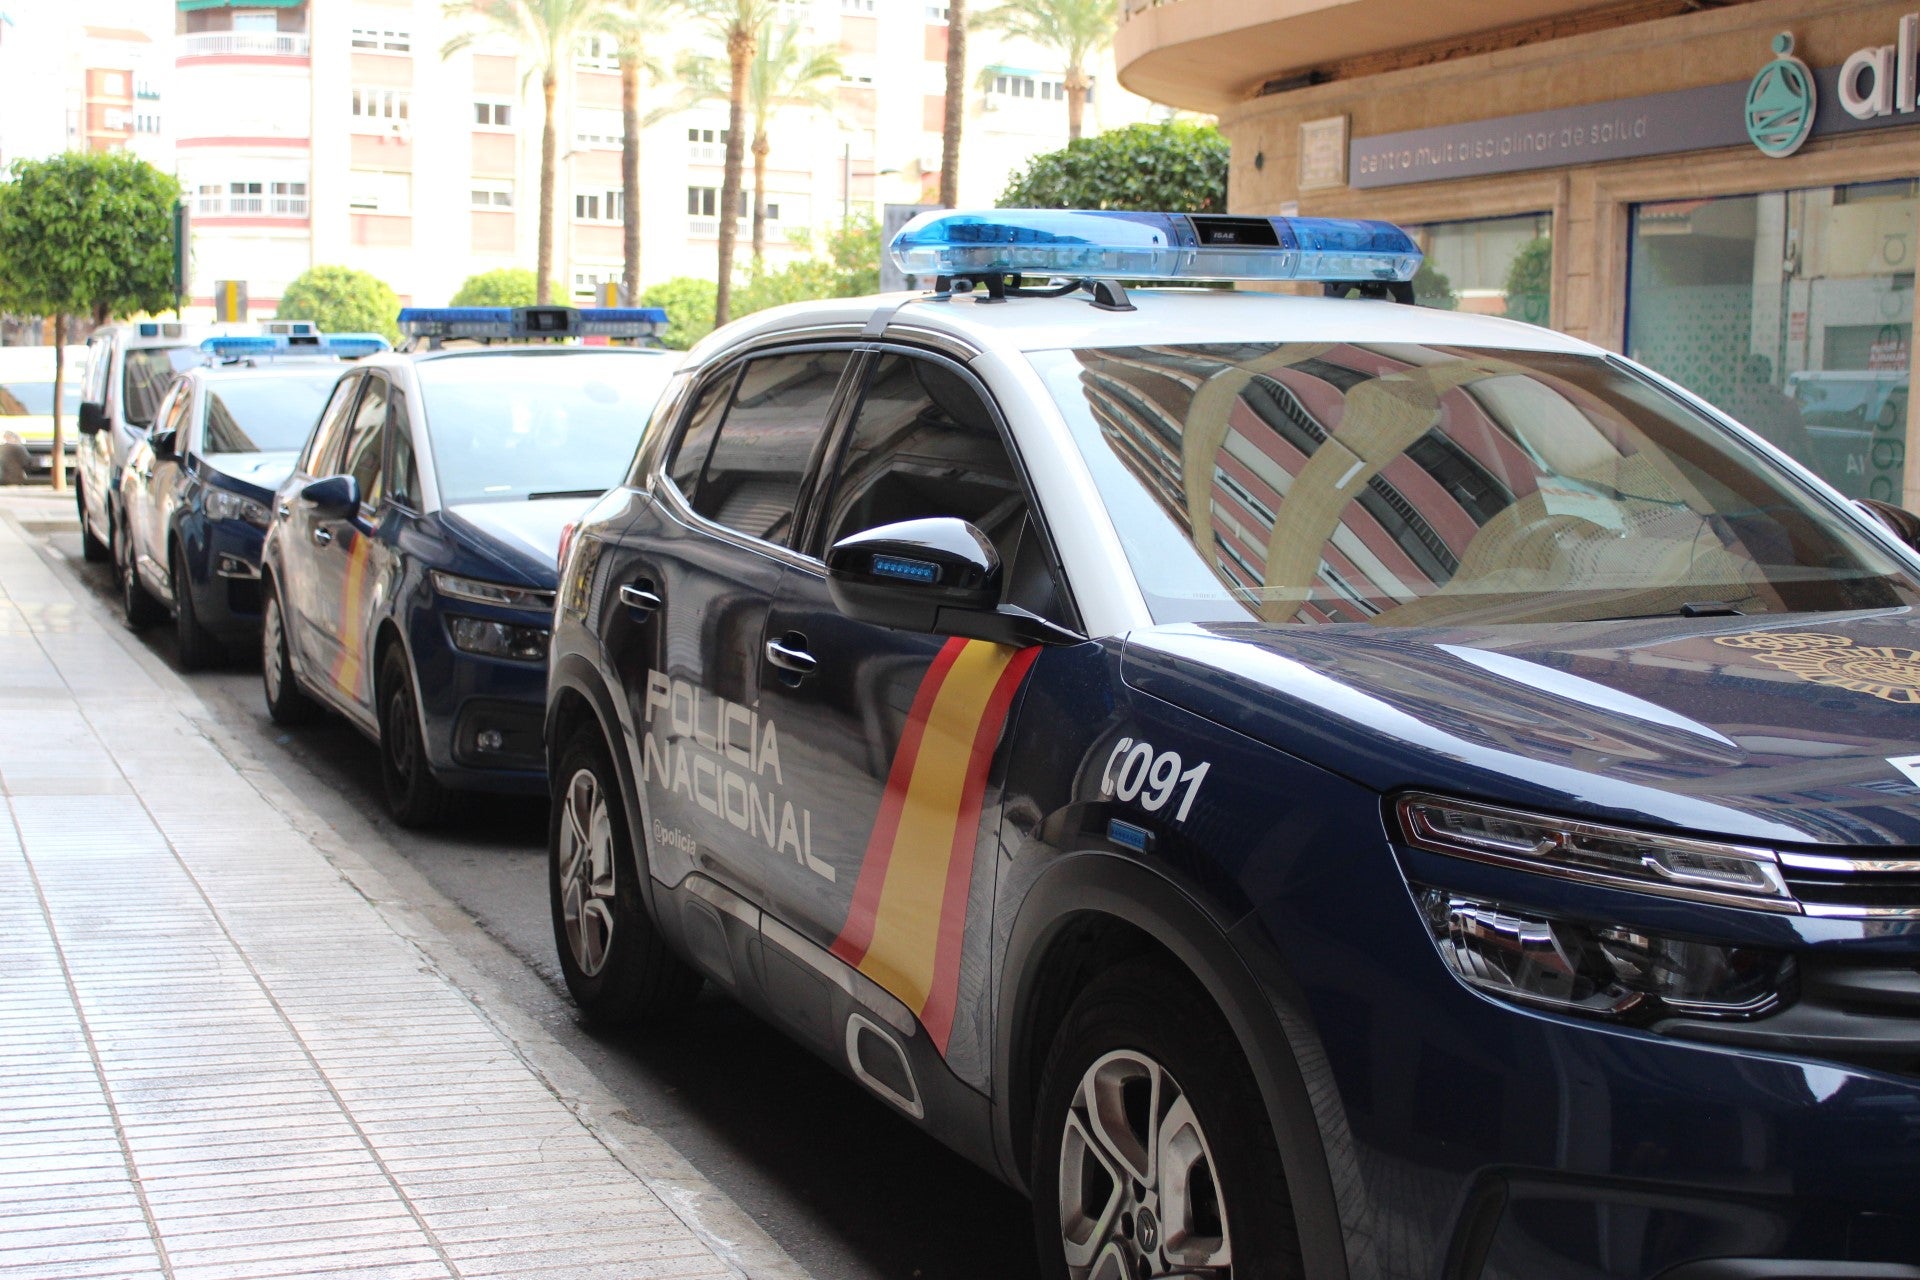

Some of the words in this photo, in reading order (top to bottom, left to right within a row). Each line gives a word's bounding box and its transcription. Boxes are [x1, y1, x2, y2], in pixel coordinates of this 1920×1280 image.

[1838, 13, 1920, 120] al
[1359, 149, 1410, 174] centro
[1560, 125, 1585, 148] de
[1590, 114, 1648, 145] salud
[645, 668, 783, 785] POLICÍA
[644, 731, 836, 883] NACIONAL
[1116, 742, 1211, 823] 091
[654, 818, 697, 856] @policia
